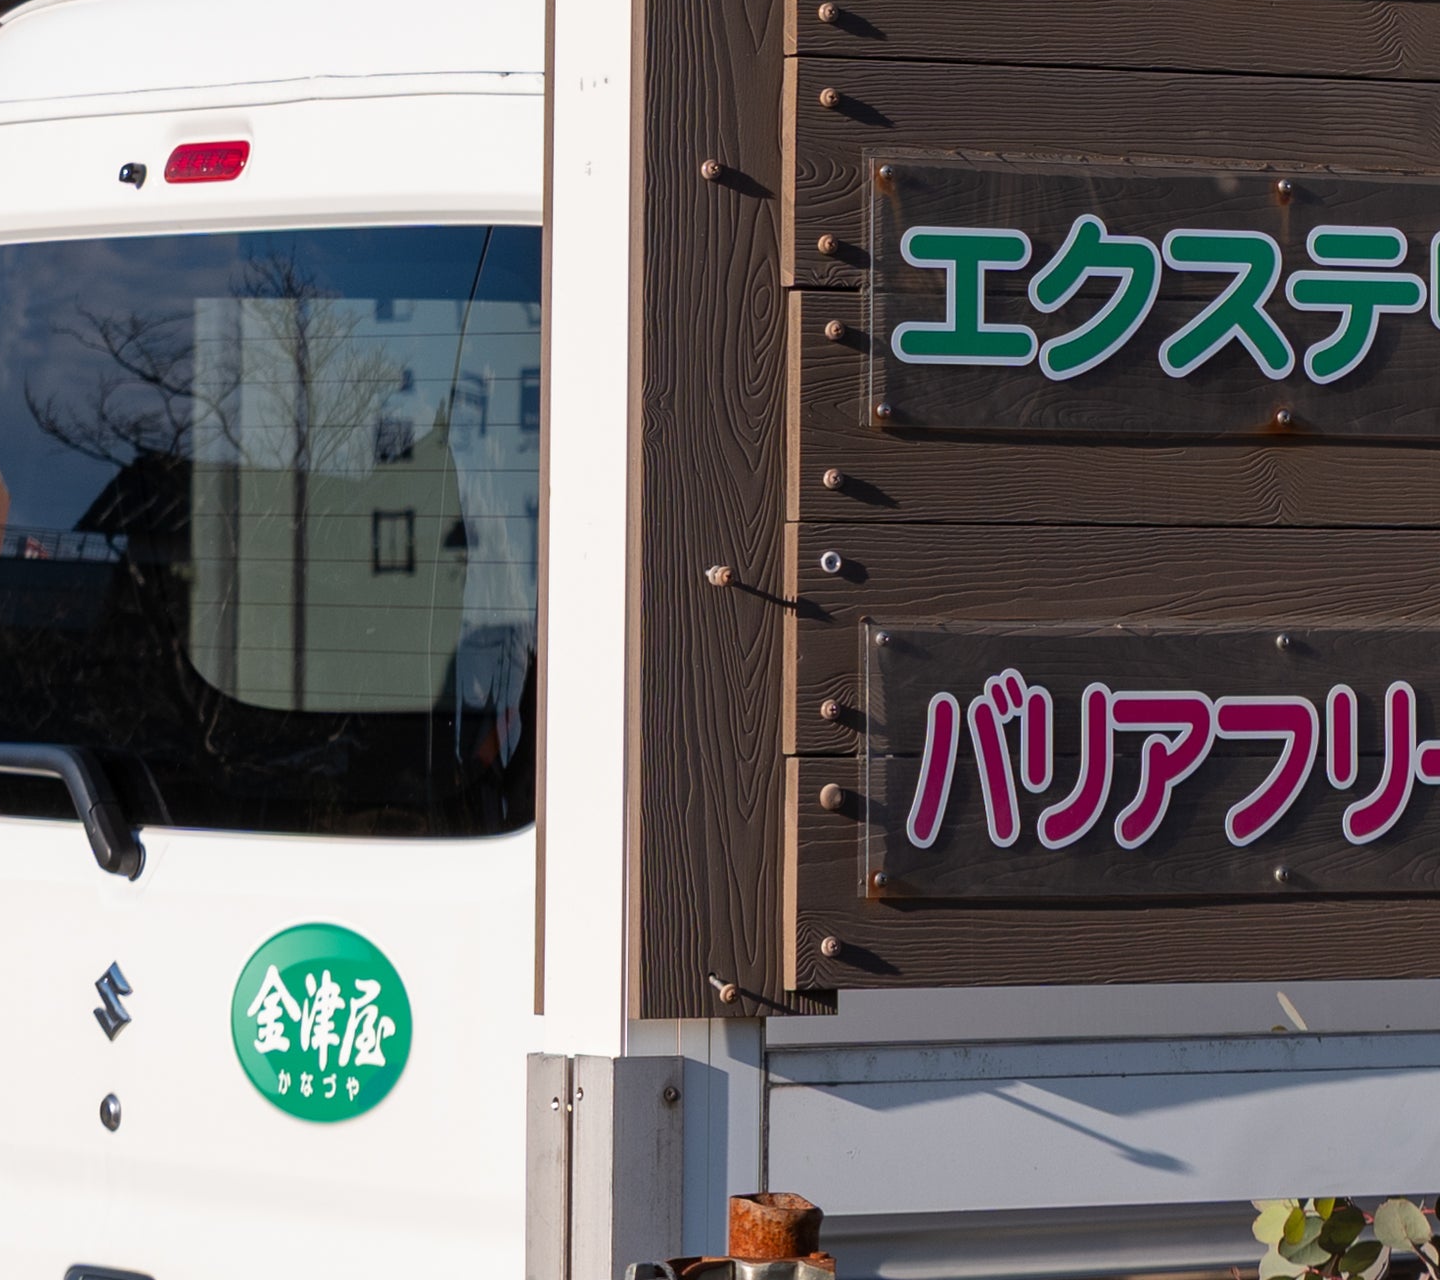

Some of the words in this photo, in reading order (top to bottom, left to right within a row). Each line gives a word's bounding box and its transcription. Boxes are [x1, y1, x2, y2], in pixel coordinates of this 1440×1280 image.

[247, 964, 396, 1071] 金津屋
[278, 1069, 360, 1102] かなづや
